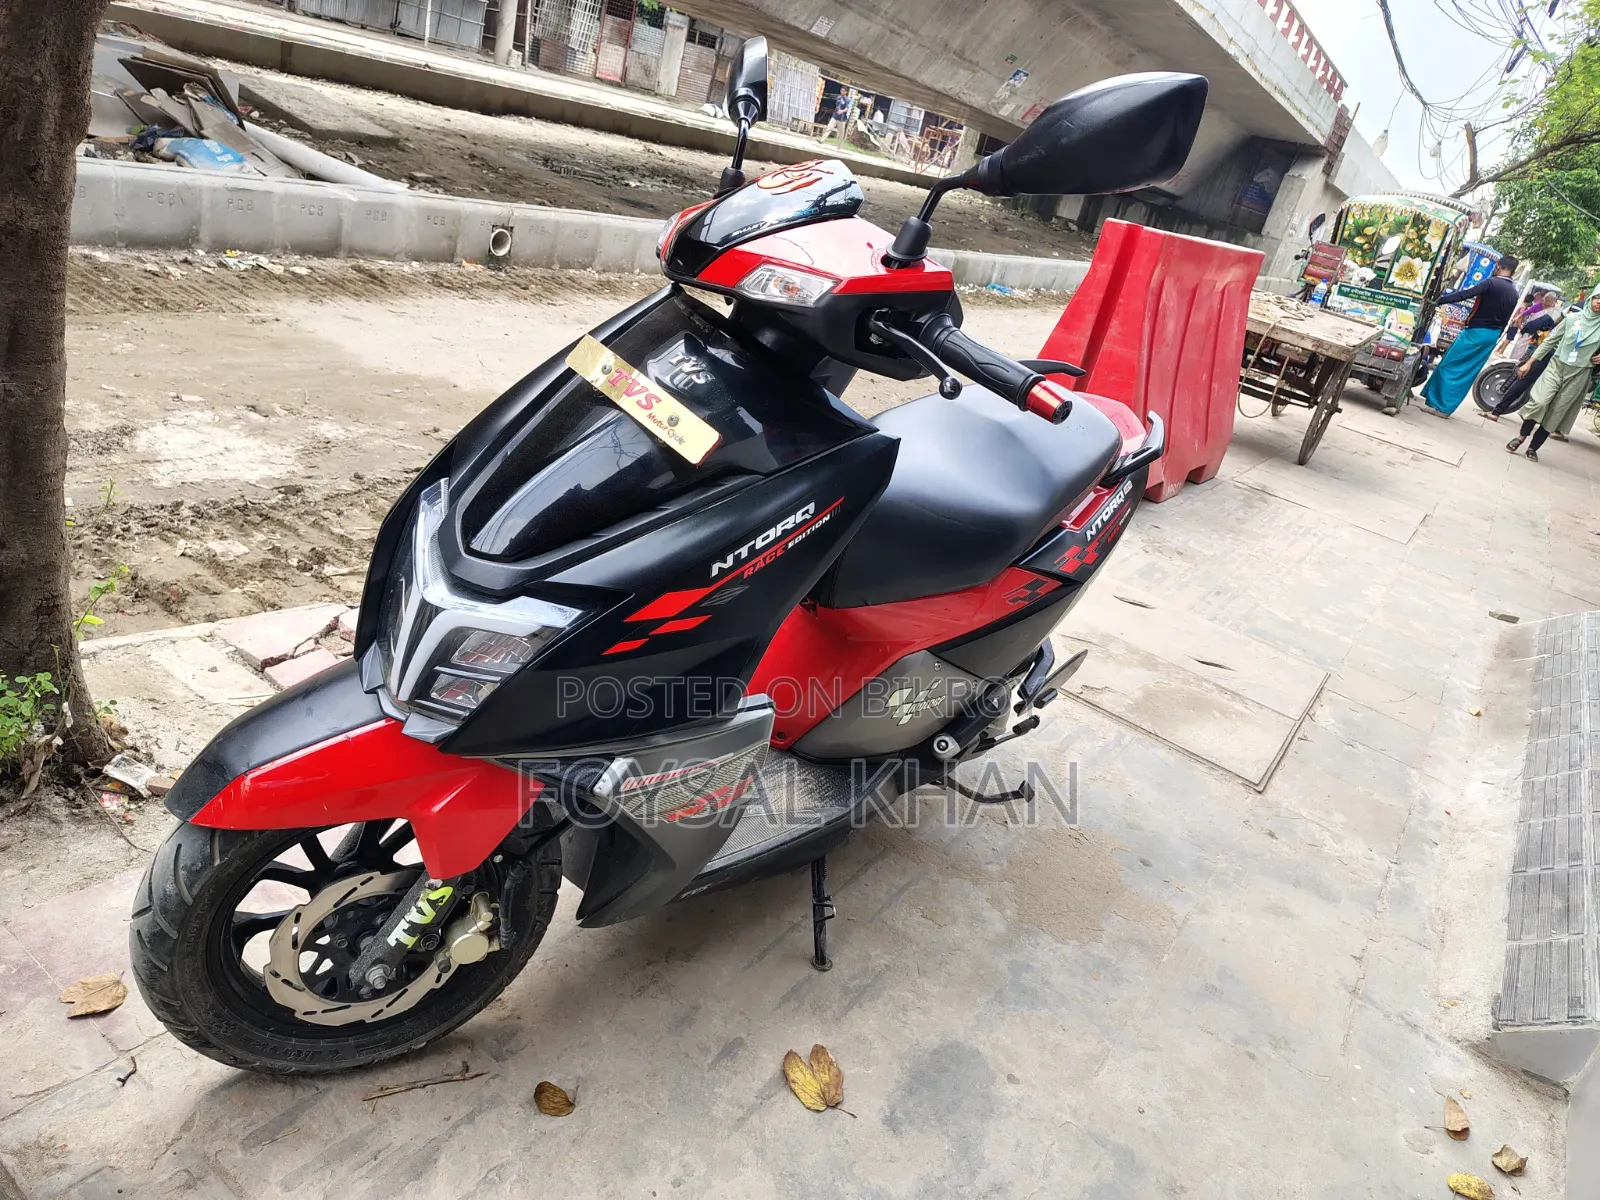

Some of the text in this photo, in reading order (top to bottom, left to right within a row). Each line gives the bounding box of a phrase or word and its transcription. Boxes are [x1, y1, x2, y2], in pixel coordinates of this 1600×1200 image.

[608, 368, 662, 411] TVS
[668, 352, 716, 385] TVS
[667, 427, 686, 445] Cycle
[710, 501, 816, 579] NTORQ
[1086, 490, 1125, 542] NTORQ
[743, 513, 831, 579] RACE EDITION
[387, 886, 454, 949] TVS
